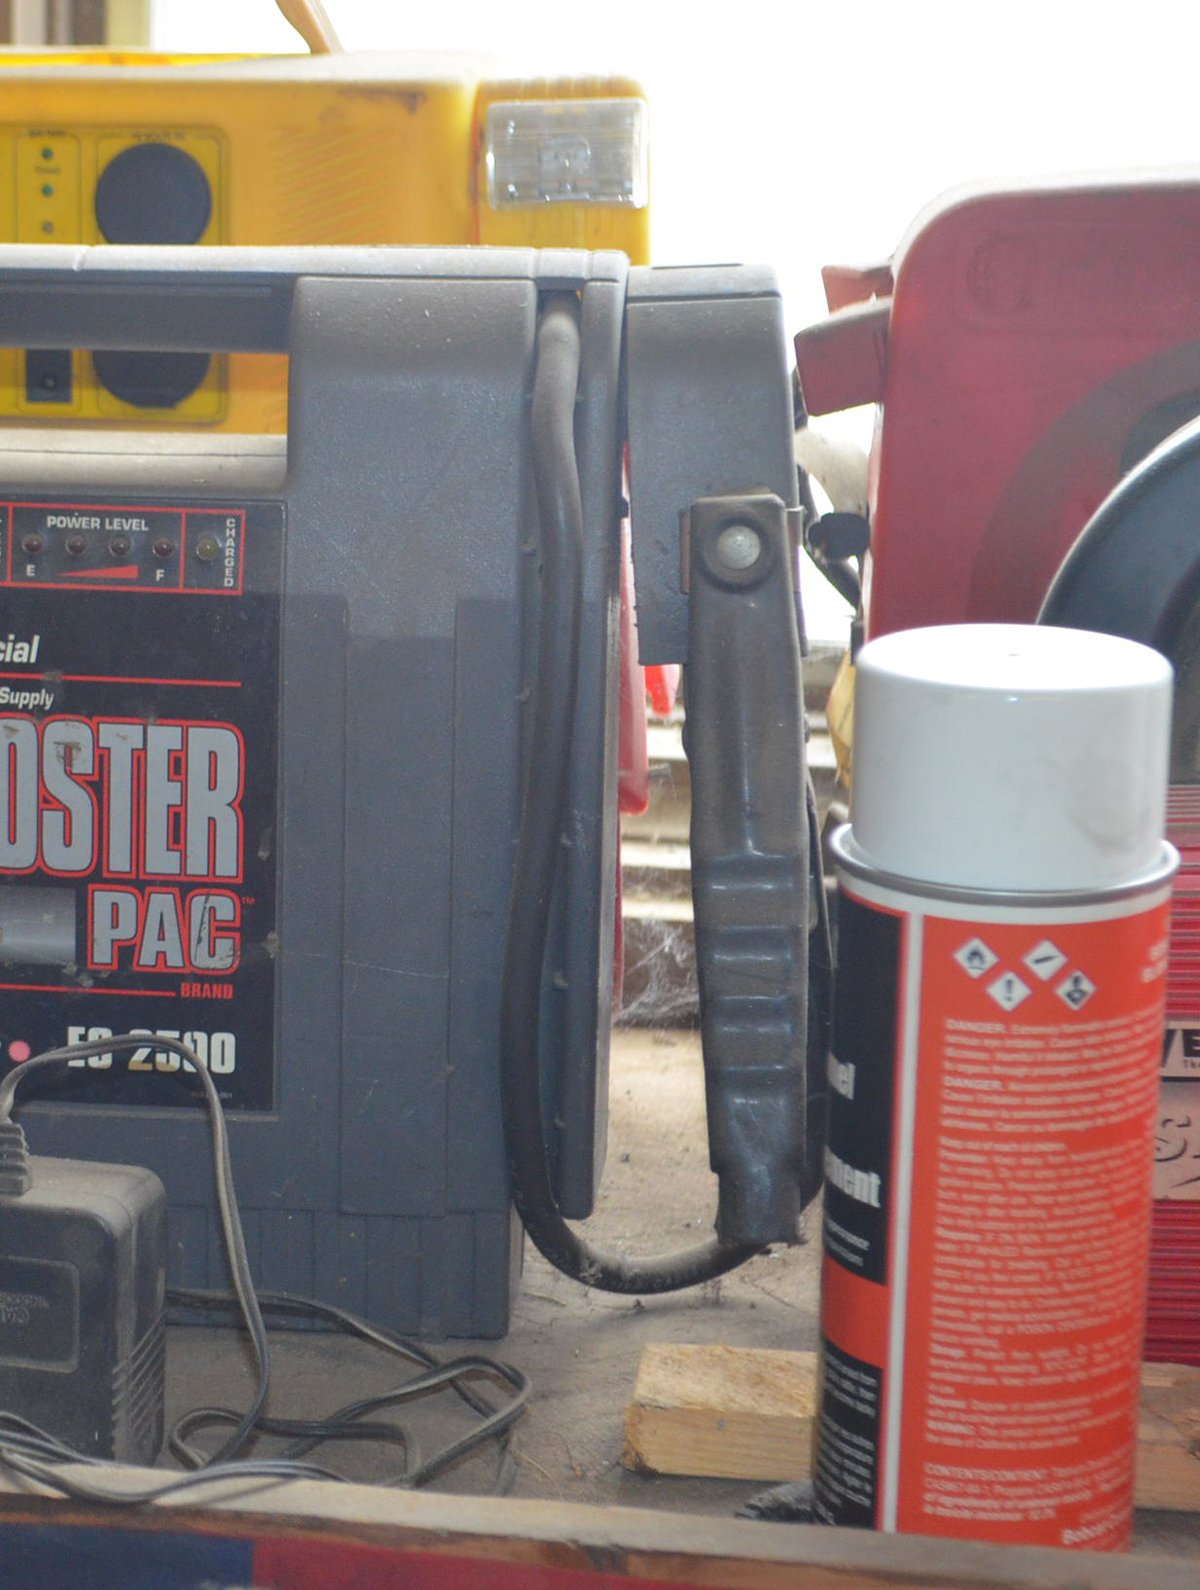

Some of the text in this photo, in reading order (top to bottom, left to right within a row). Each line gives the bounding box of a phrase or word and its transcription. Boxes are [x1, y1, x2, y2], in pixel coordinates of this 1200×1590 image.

[47, 514, 149, 532] POWER LEVEL
[26, 564, 35, 577] E
[156, 569, 165, 582] F
[87, 882, 243, 976] PAC
[181, 983, 233, 1000] BRAND
[128, 1028, 236, 1075] 2500
